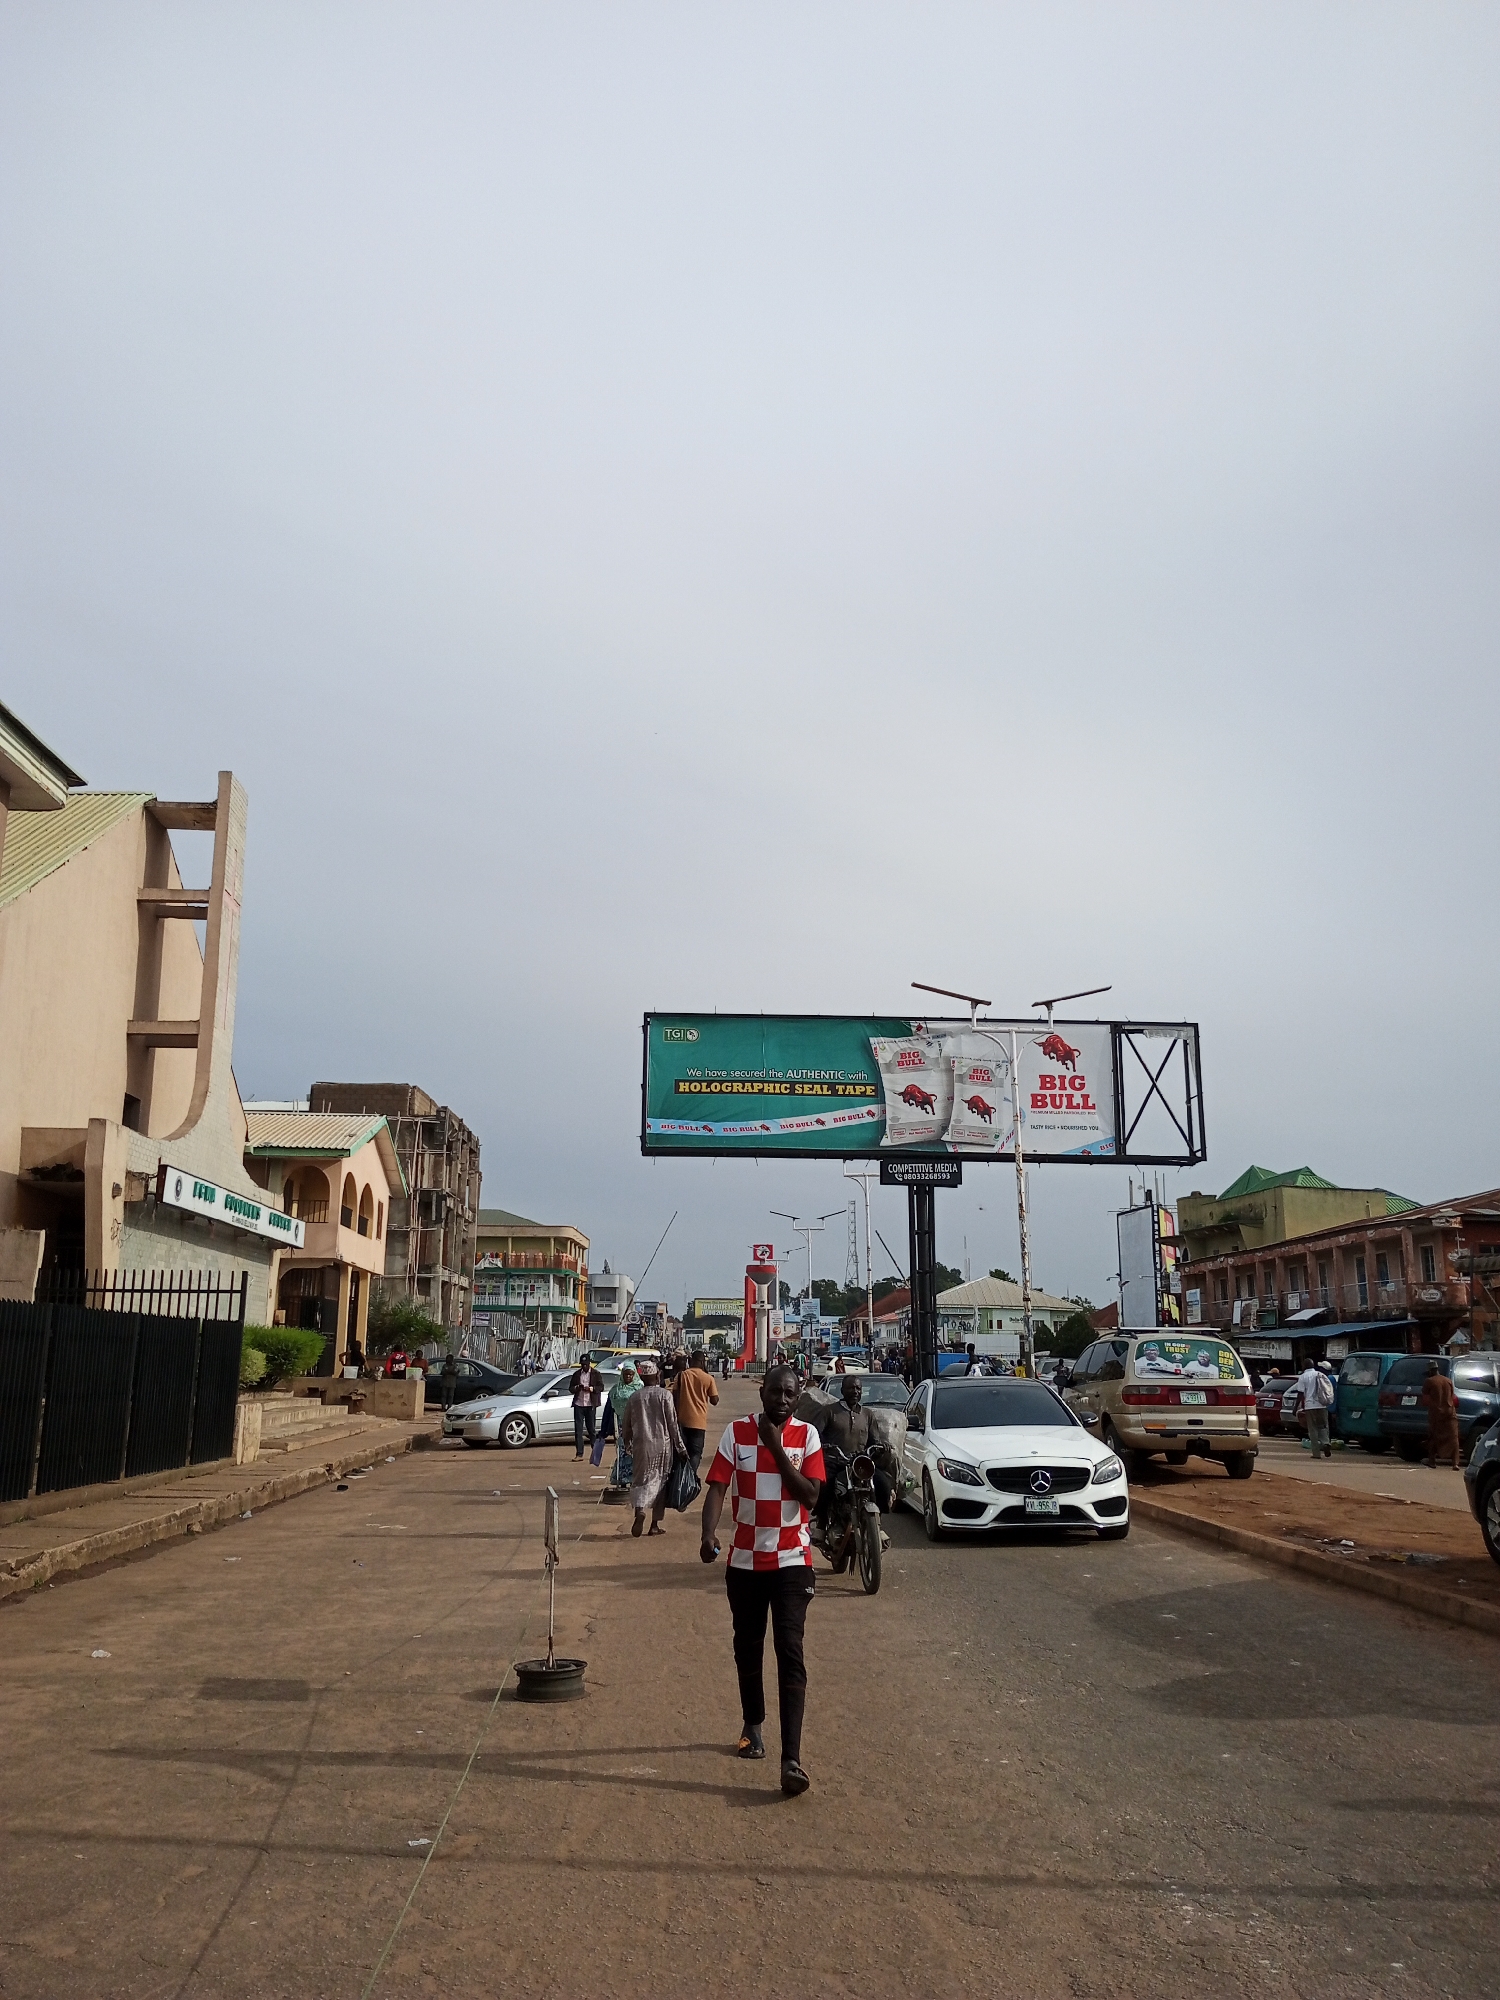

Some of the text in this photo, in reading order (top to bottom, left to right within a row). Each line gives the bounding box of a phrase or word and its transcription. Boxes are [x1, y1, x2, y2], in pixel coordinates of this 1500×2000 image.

[665, 1029, 684, 1038] TGI
[899, 1051, 920, 1060] BIG
[896, 1058, 926, 1068] BULL
[686, 1067, 868, 1080] We have secured the AUTHENTIC with
[968, 1074, 993, 1082] BULL
[1038, 1074, 1086, 1092] BIG
[678, 1081, 876, 1096] HOLOGRAPHIC SEAL TAPE
[1030, 1093, 1096, 1110] BULL
[833, 1112, 866, 1124] BIG BULL
[678, 1124, 701, 1132] BULL
[795, 1121, 815, 1129] BULL
[1100, 1142, 1114, 1151] BIG
[888, 1163, 958, 1173] COMPETITIVE MEDIA
[1165, 1346, 1190, 1354] TRUST
